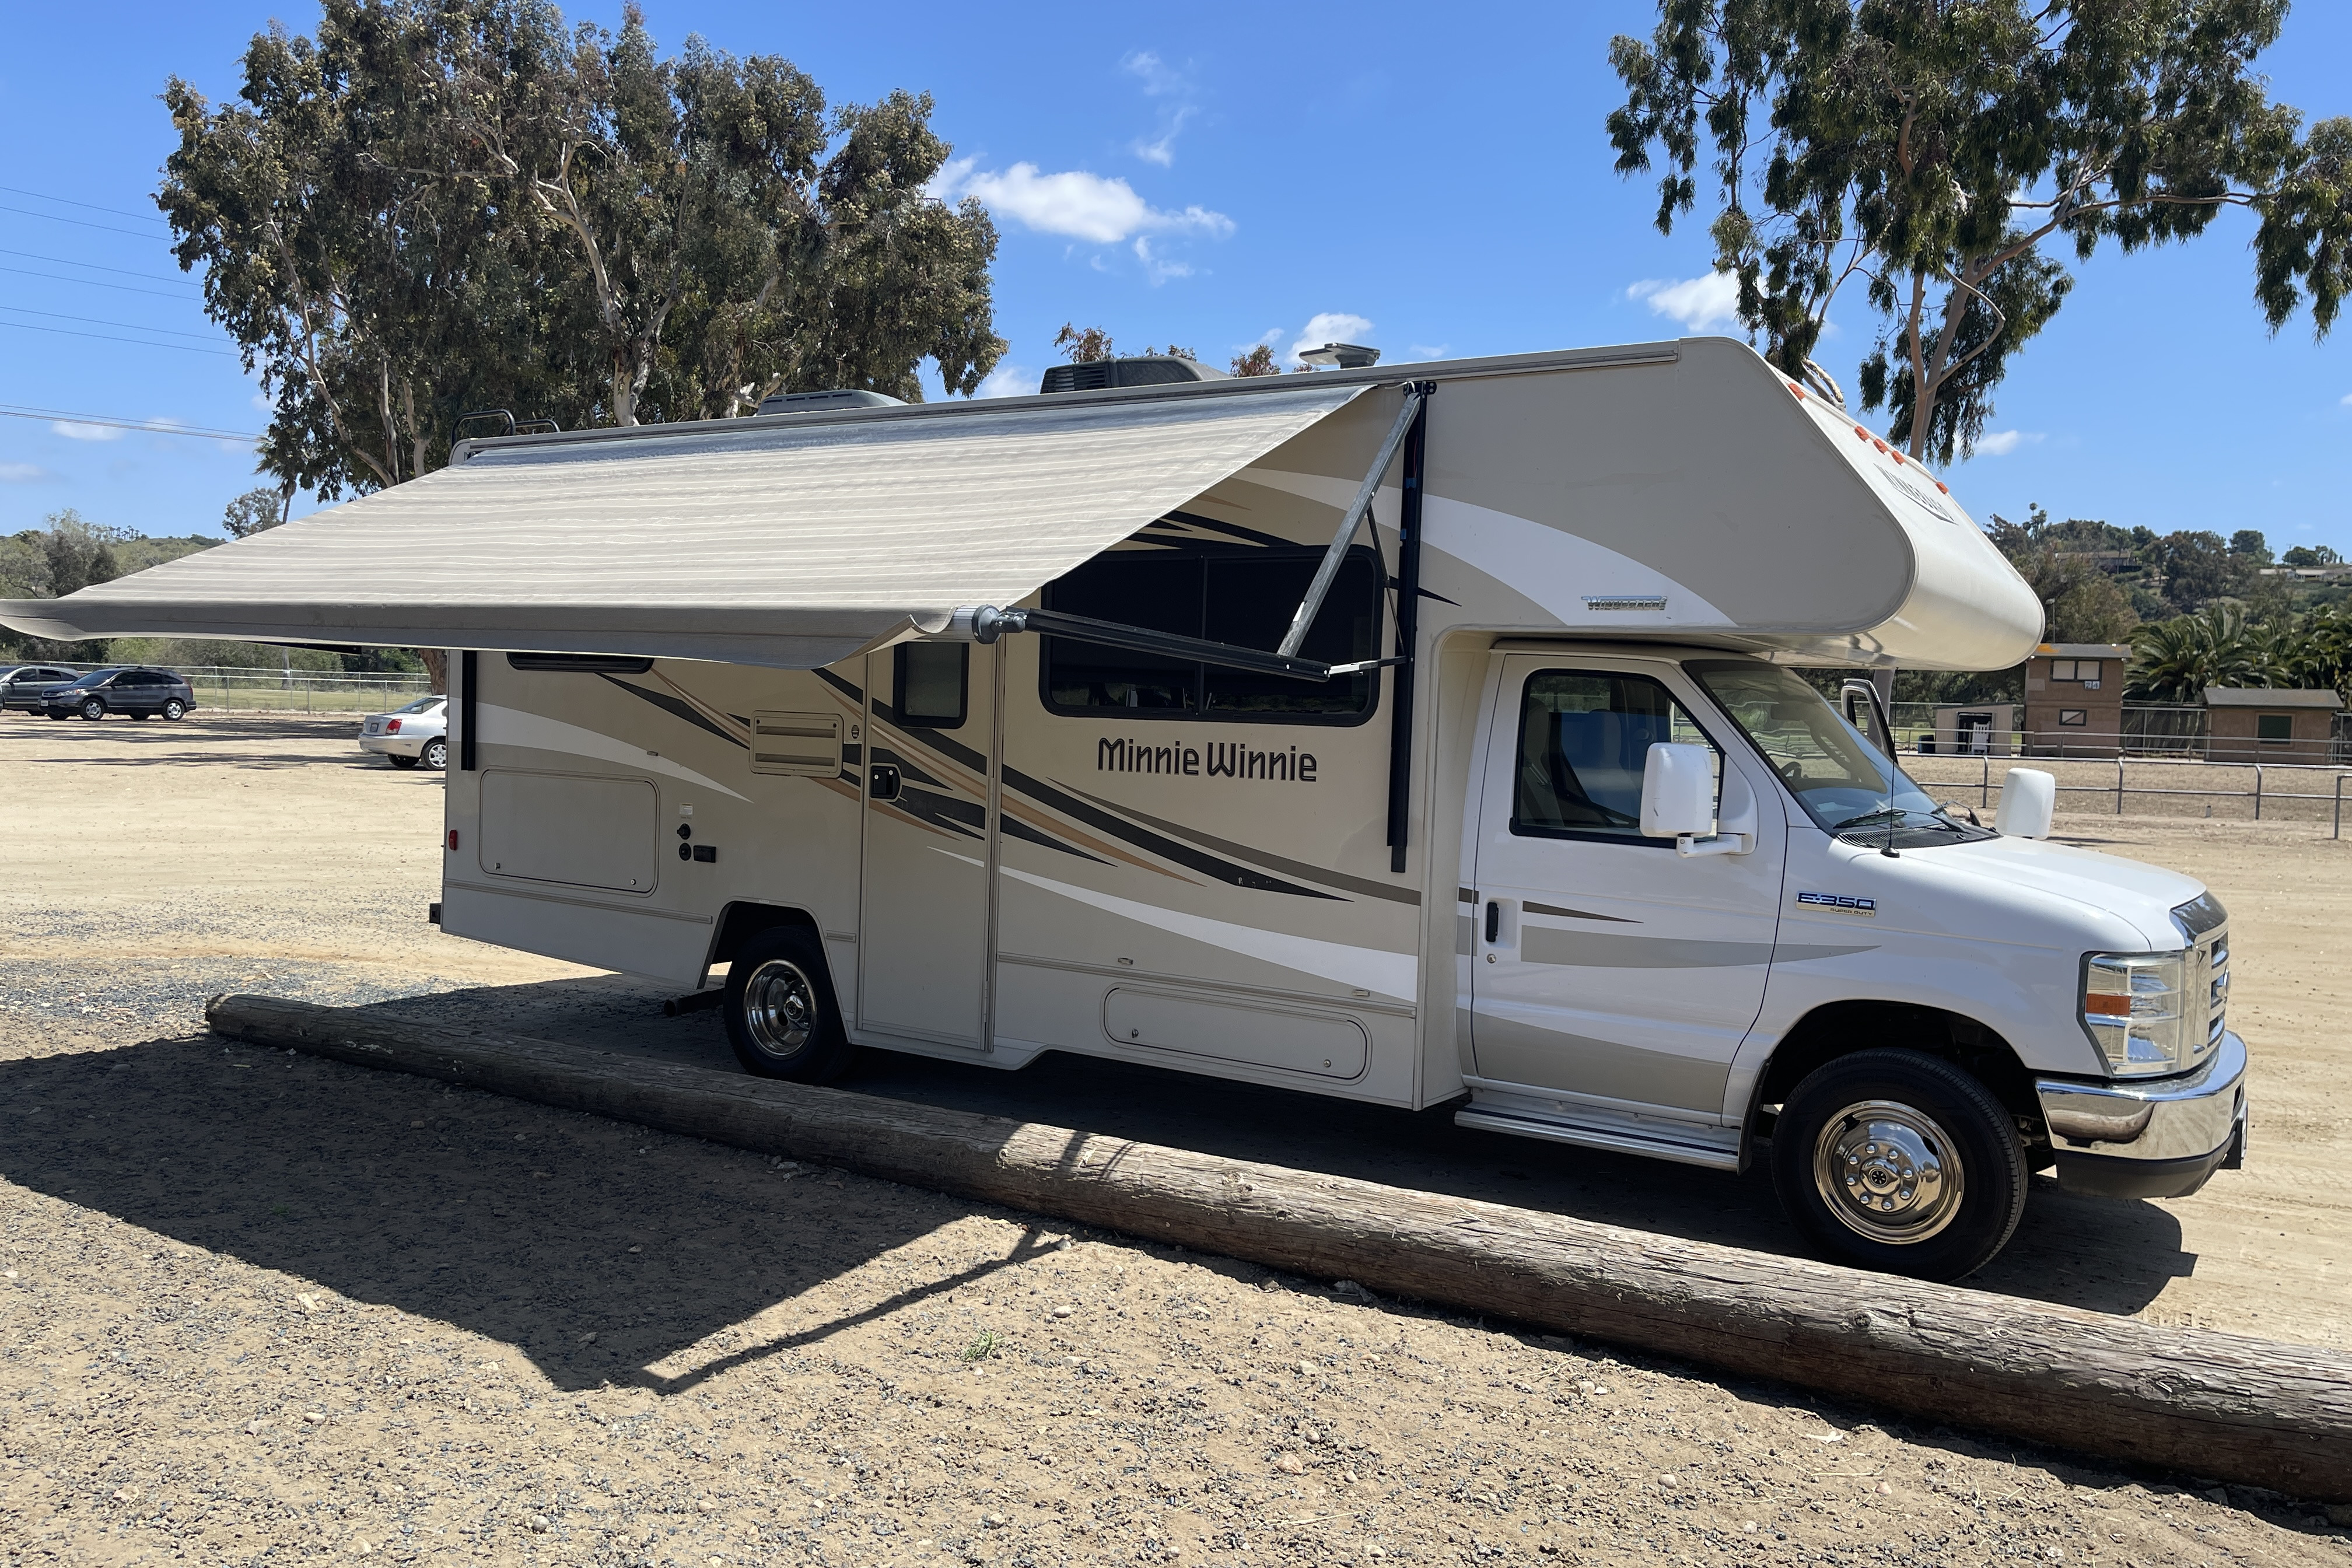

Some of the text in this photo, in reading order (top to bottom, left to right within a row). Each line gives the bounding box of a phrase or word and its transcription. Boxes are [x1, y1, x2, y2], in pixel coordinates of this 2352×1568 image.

[1097, 737, 1317, 782] Minnie Winnie
[1798, 892, 1875, 910] E-350
